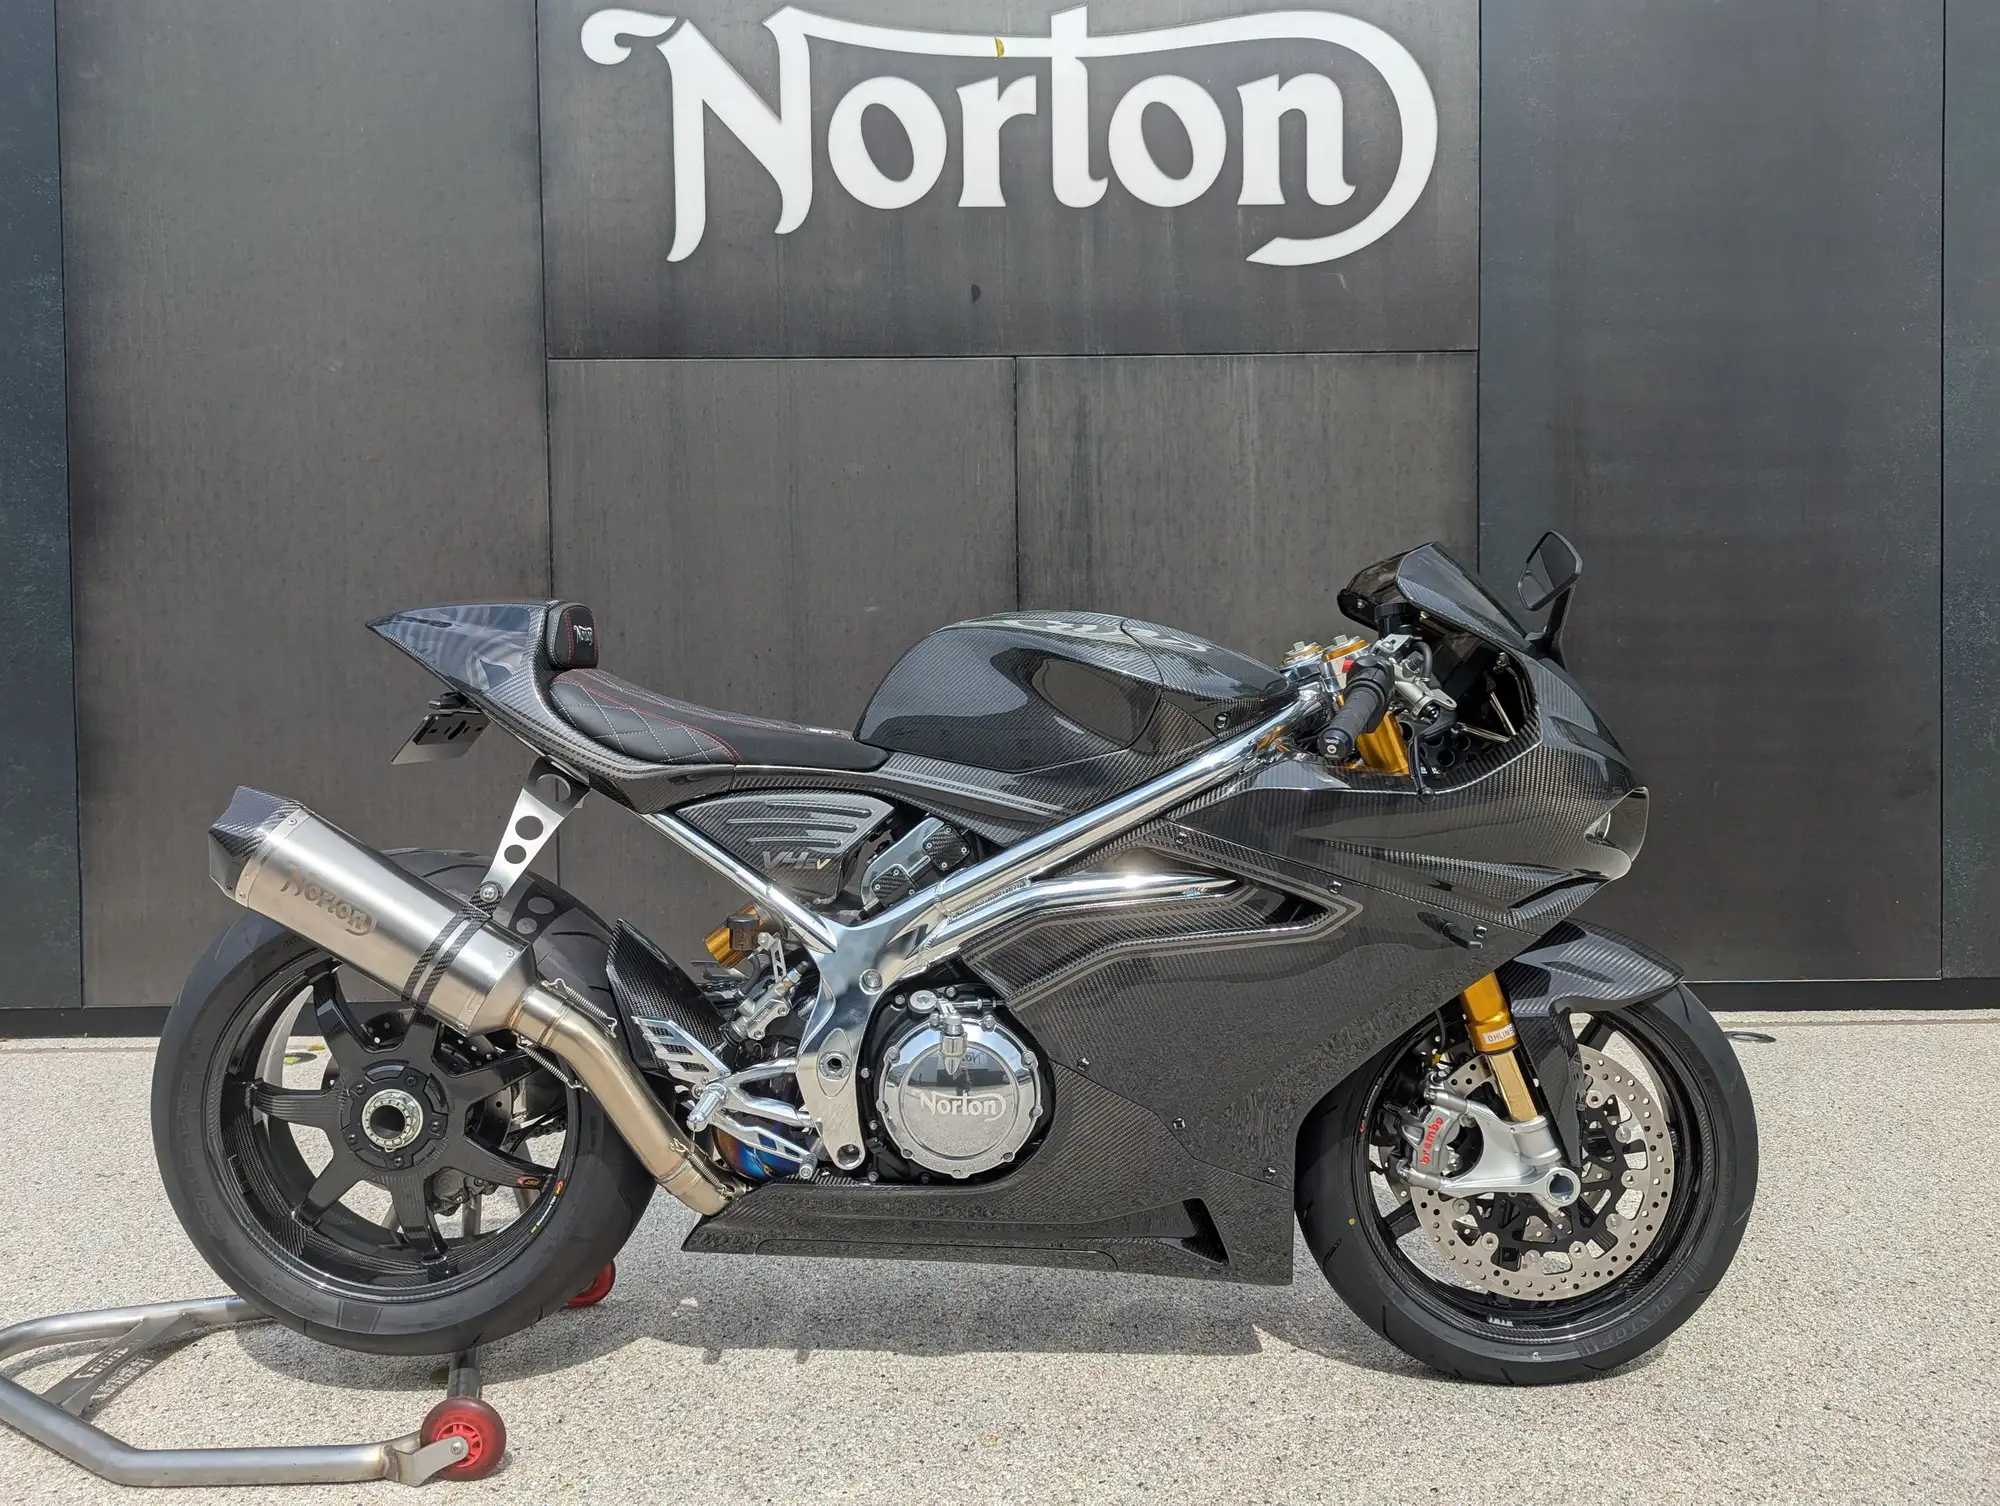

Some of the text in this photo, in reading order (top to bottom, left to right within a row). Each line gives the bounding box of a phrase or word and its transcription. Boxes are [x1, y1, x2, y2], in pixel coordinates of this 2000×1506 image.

[581, 4, 1438, 267] Norton
[279, 861, 378, 937] Norton
[912, 1088, 1007, 1122] Norton
[1419, 1116, 1444, 1165] brembo
